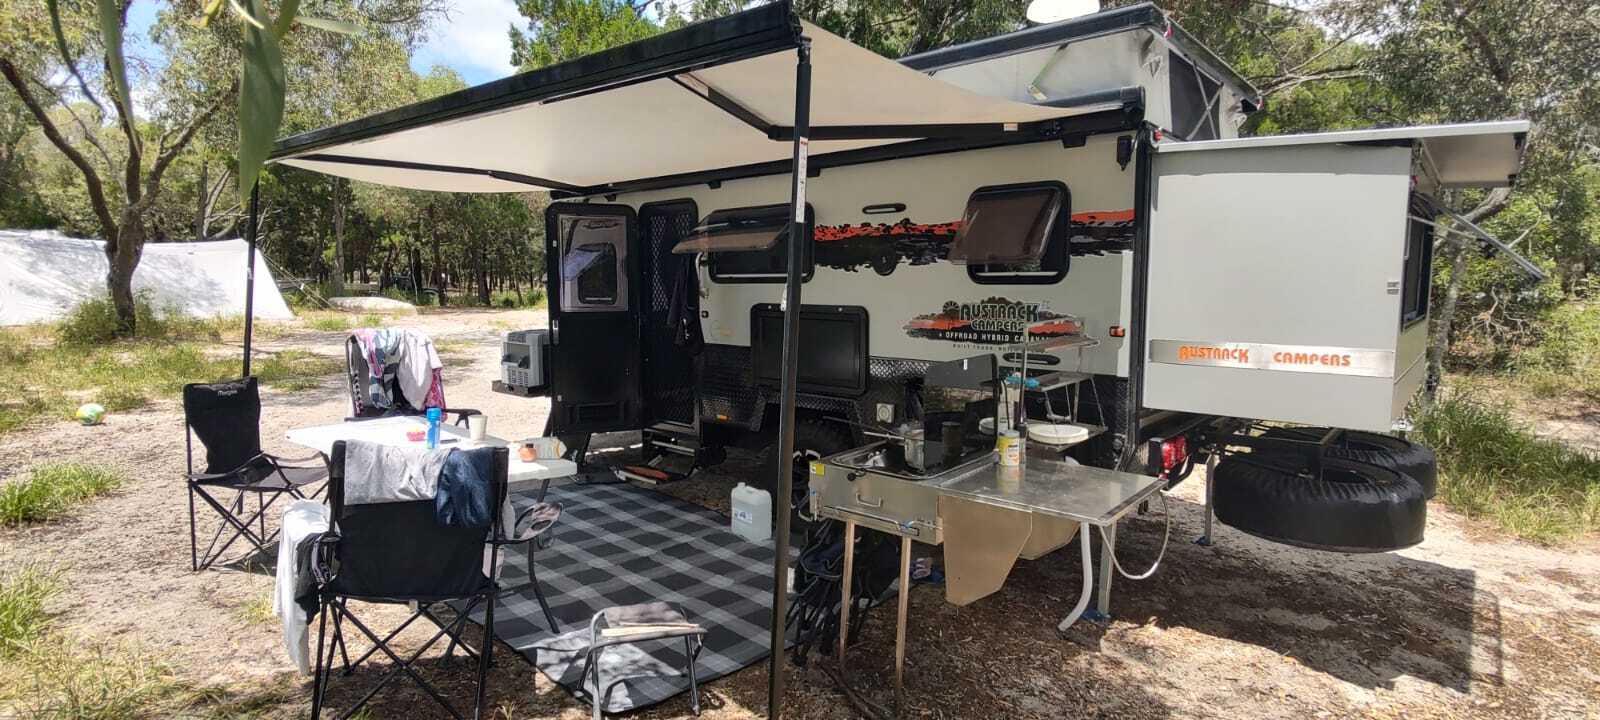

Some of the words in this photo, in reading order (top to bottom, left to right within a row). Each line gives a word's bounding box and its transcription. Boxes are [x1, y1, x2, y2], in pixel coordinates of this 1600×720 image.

[960, 303, 1039, 322] AUSTRACK
[971, 320, 1024, 332] CAMPERS
[945, 331, 978, 340] OFFROAD
[981, 333, 1010, 342] HYBRID
[1178, 345, 1249, 363] AUSTRACK
[1273, 351, 1351, 367] CAMPERS
